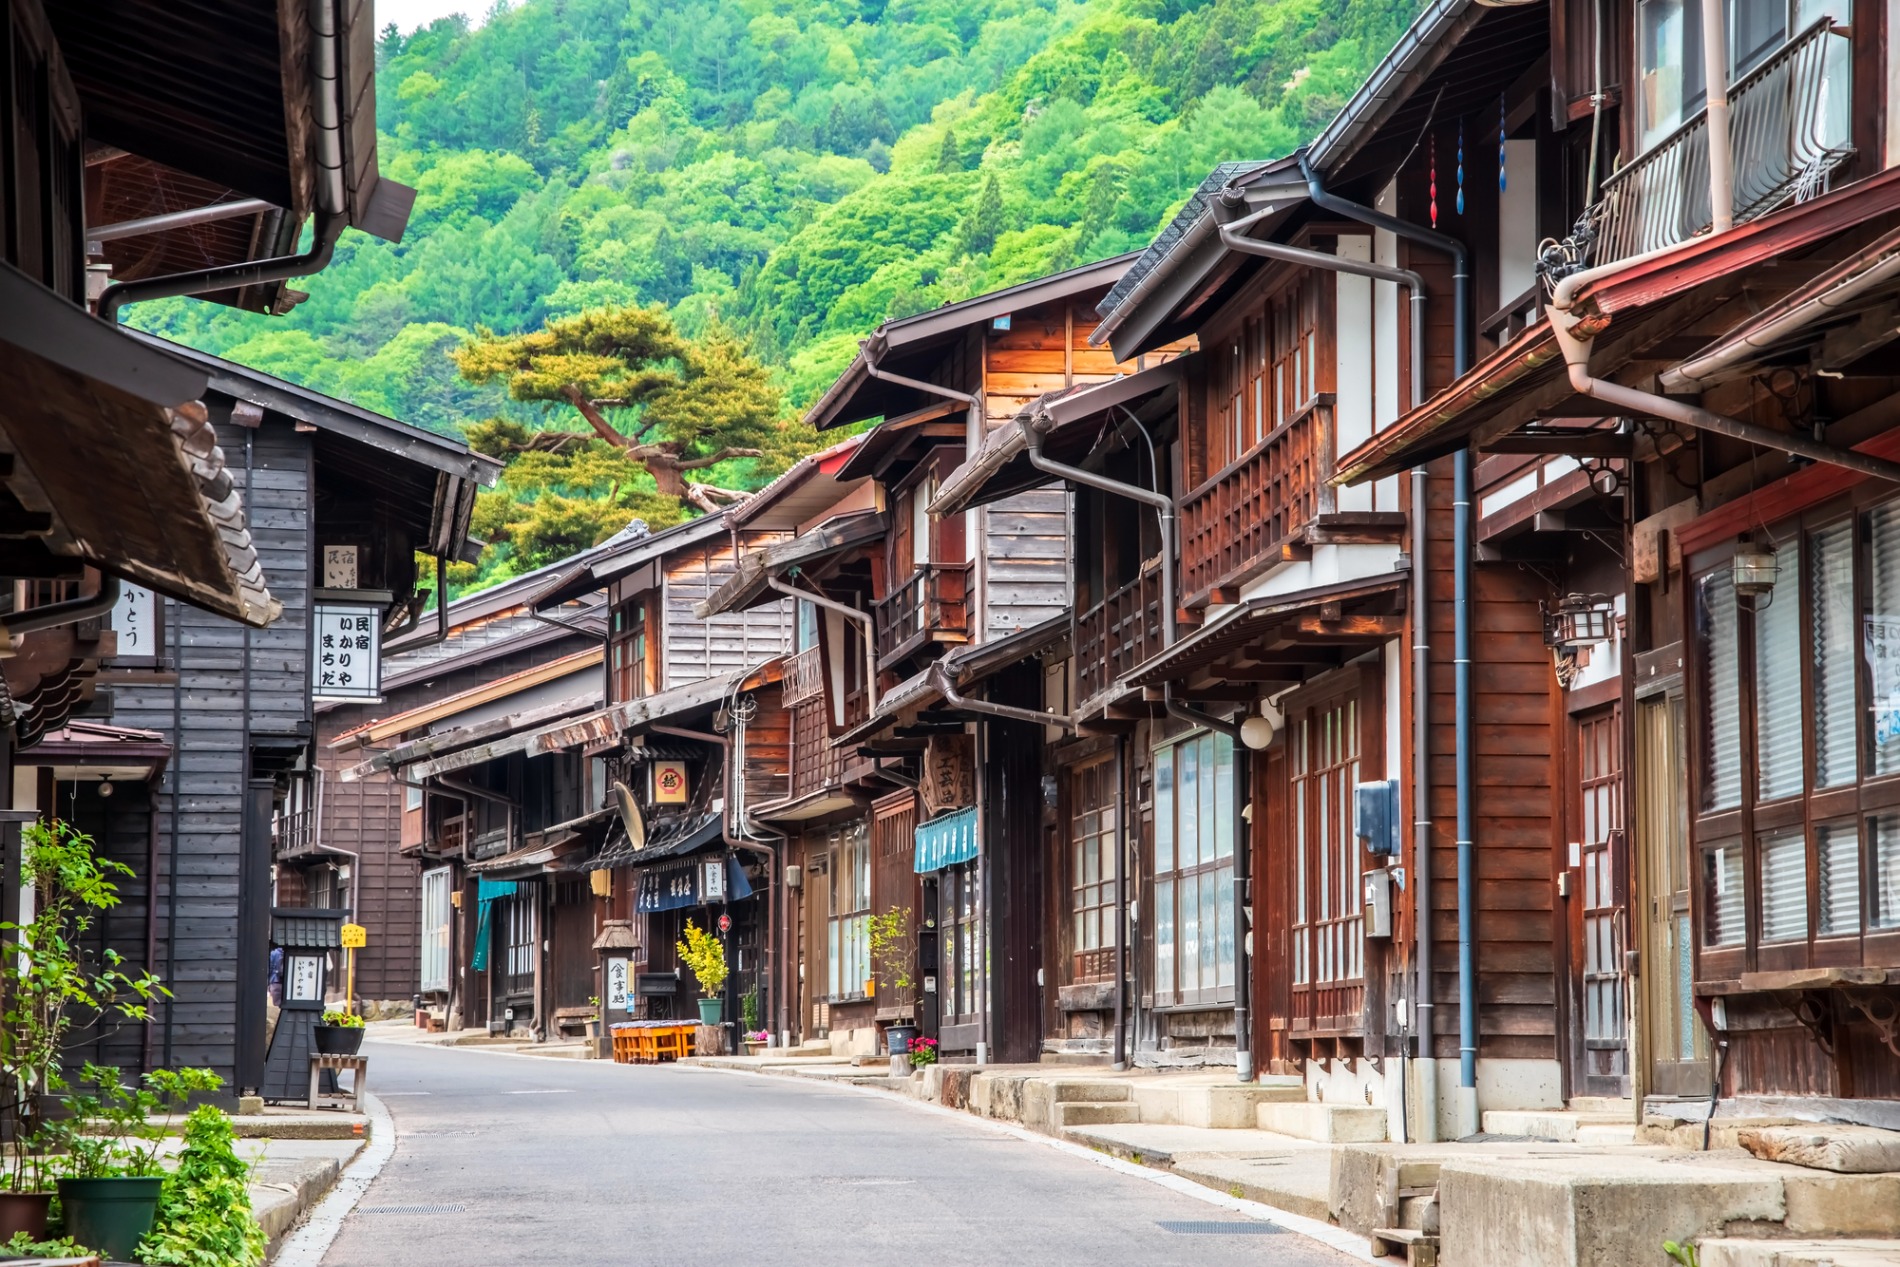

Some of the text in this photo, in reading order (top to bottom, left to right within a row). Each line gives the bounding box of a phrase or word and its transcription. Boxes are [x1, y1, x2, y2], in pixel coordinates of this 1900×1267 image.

[328, 550, 355, 565] 民宿
[123, 588, 145, 647] かとう
[355, 616, 370, 650] 民宿
[322, 633, 336, 686] まちだ
[338, 616, 353, 687] いかりや
